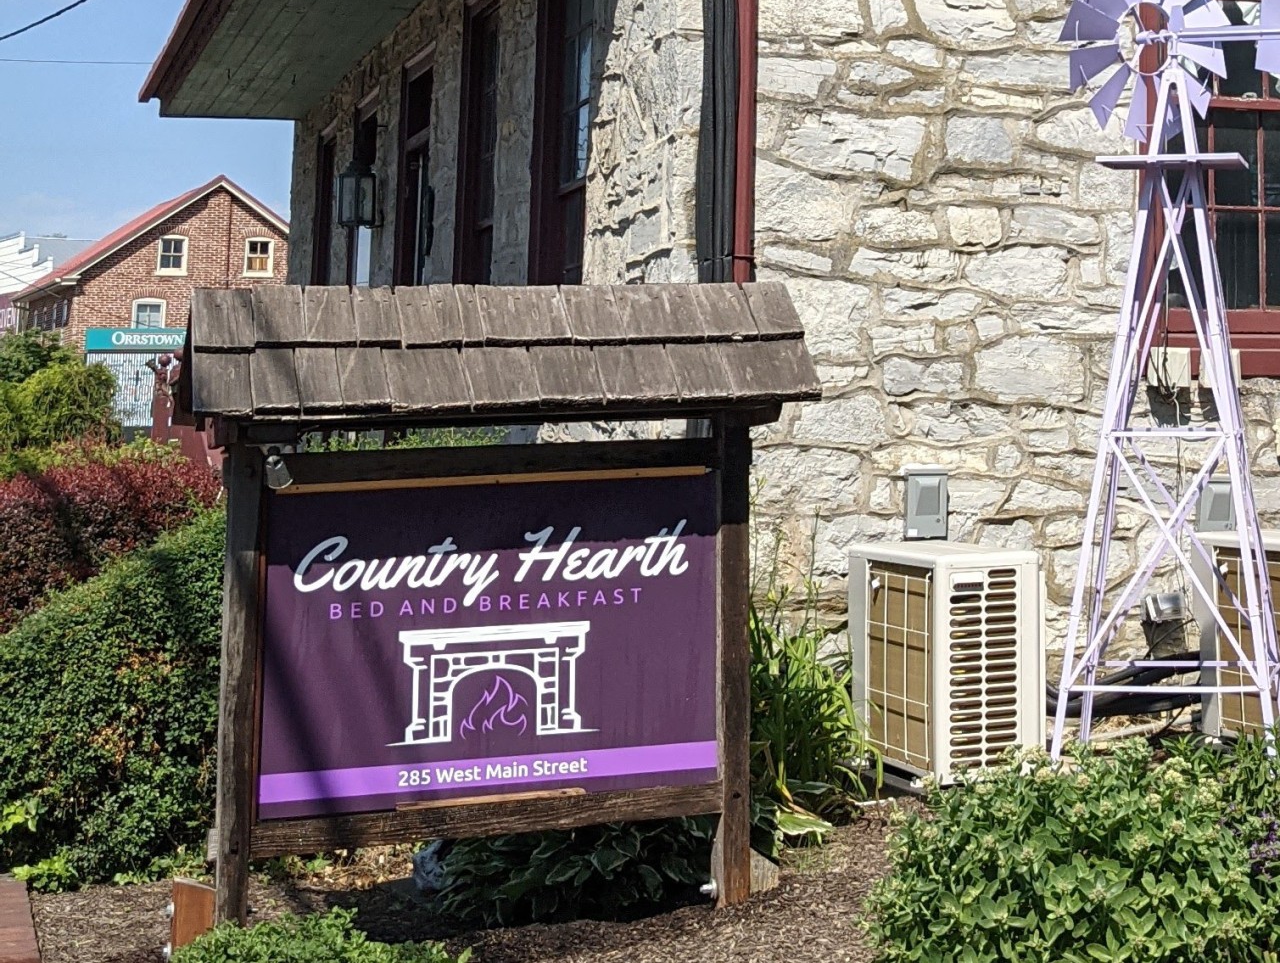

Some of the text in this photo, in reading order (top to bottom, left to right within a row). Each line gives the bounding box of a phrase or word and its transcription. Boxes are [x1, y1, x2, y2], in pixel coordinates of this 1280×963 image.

[111, 331, 183, 345] ORRSTOWN
[293, 518, 689, 607] Country Hearth
[329, 587, 643, 620] BED AND BREAKFAST
[398, 757, 588, 787] 285 West Main Street
